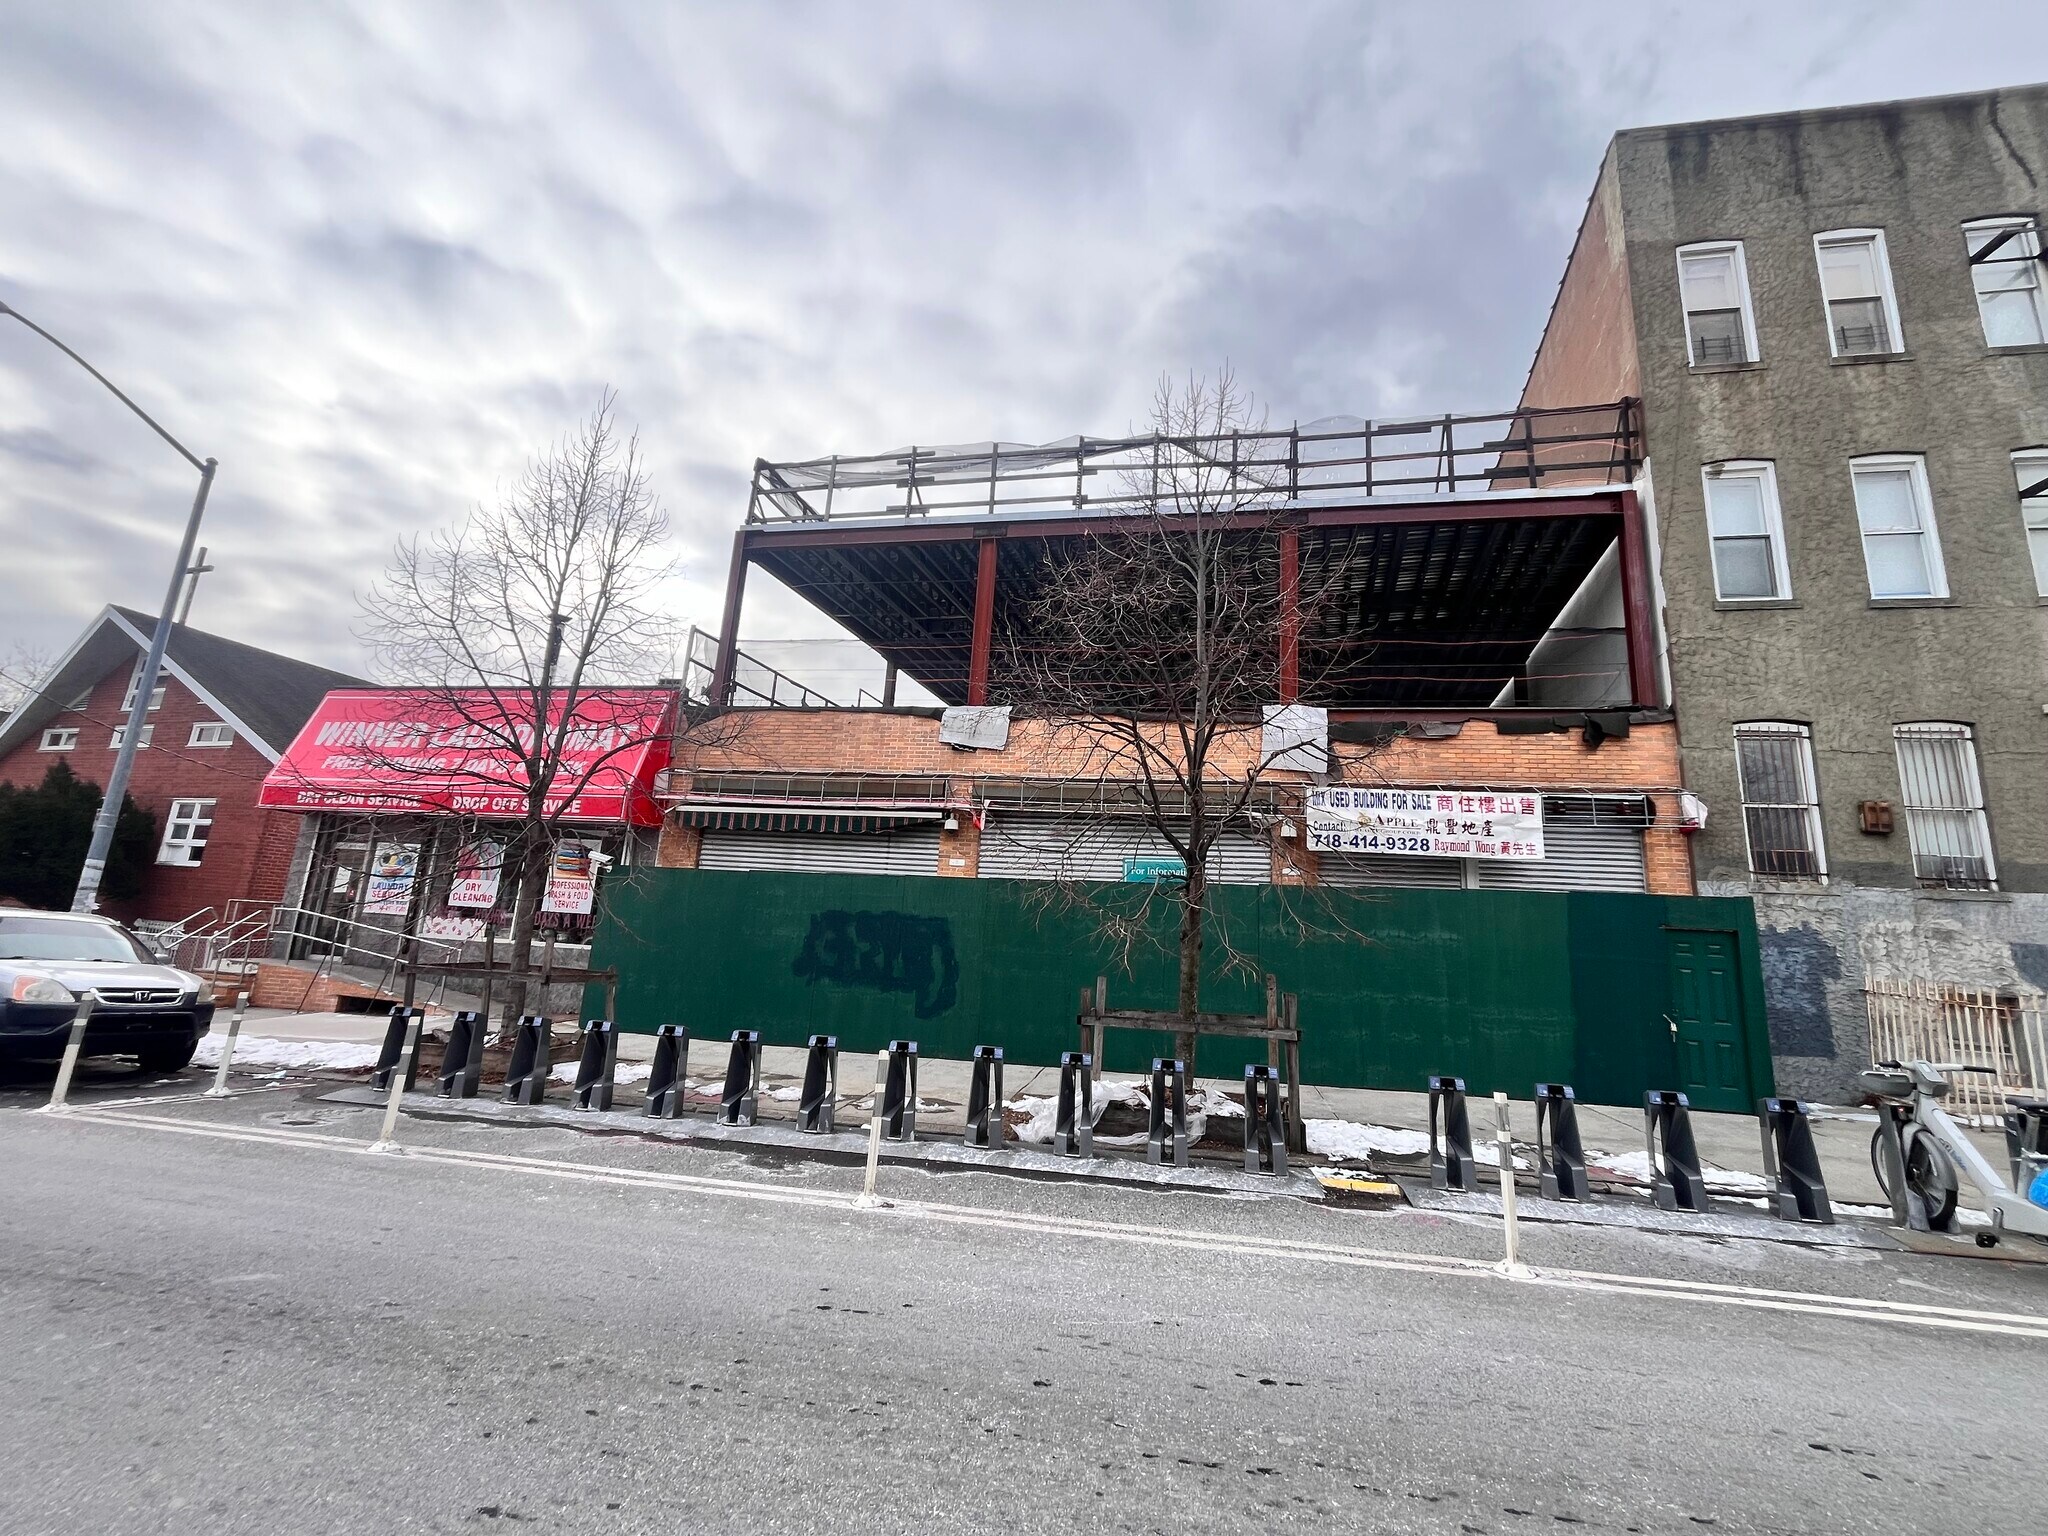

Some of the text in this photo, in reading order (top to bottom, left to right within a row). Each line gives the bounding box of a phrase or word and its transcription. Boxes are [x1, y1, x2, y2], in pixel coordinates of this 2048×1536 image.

[314, 721, 639, 752] WINNER LAUNDOMAT
[297, 791, 321, 804] DRY
[1330, 791, 1350, 808] USED
[1354, 792, 1388, 809] BUILDING
[1391, 794, 1408, 811] FOR
[1412, 795, 1432, 811] SALE
[452, 796, 582, 814] DROP OFF SRVIE
[1437, 795, 1536, 815] 商住樓出售
[1313, 820, 1347, 832] Contact:
[1375, 814, 1420, 828] APPLE
[1314, 834, 1430, 852] 718-414-9328
[1434, 839, 1496, 856] Raymond Wong
[1501, 841, 1537, 856] 黃先生
[1147, 867, 1187, 876] Informati
[465, 882, 482, 892] DRY
[452, 892, 494, 904] CLEANING
[573, 892, 589, 901] FOLD
[554, 901, 580, 910] SERVICE
